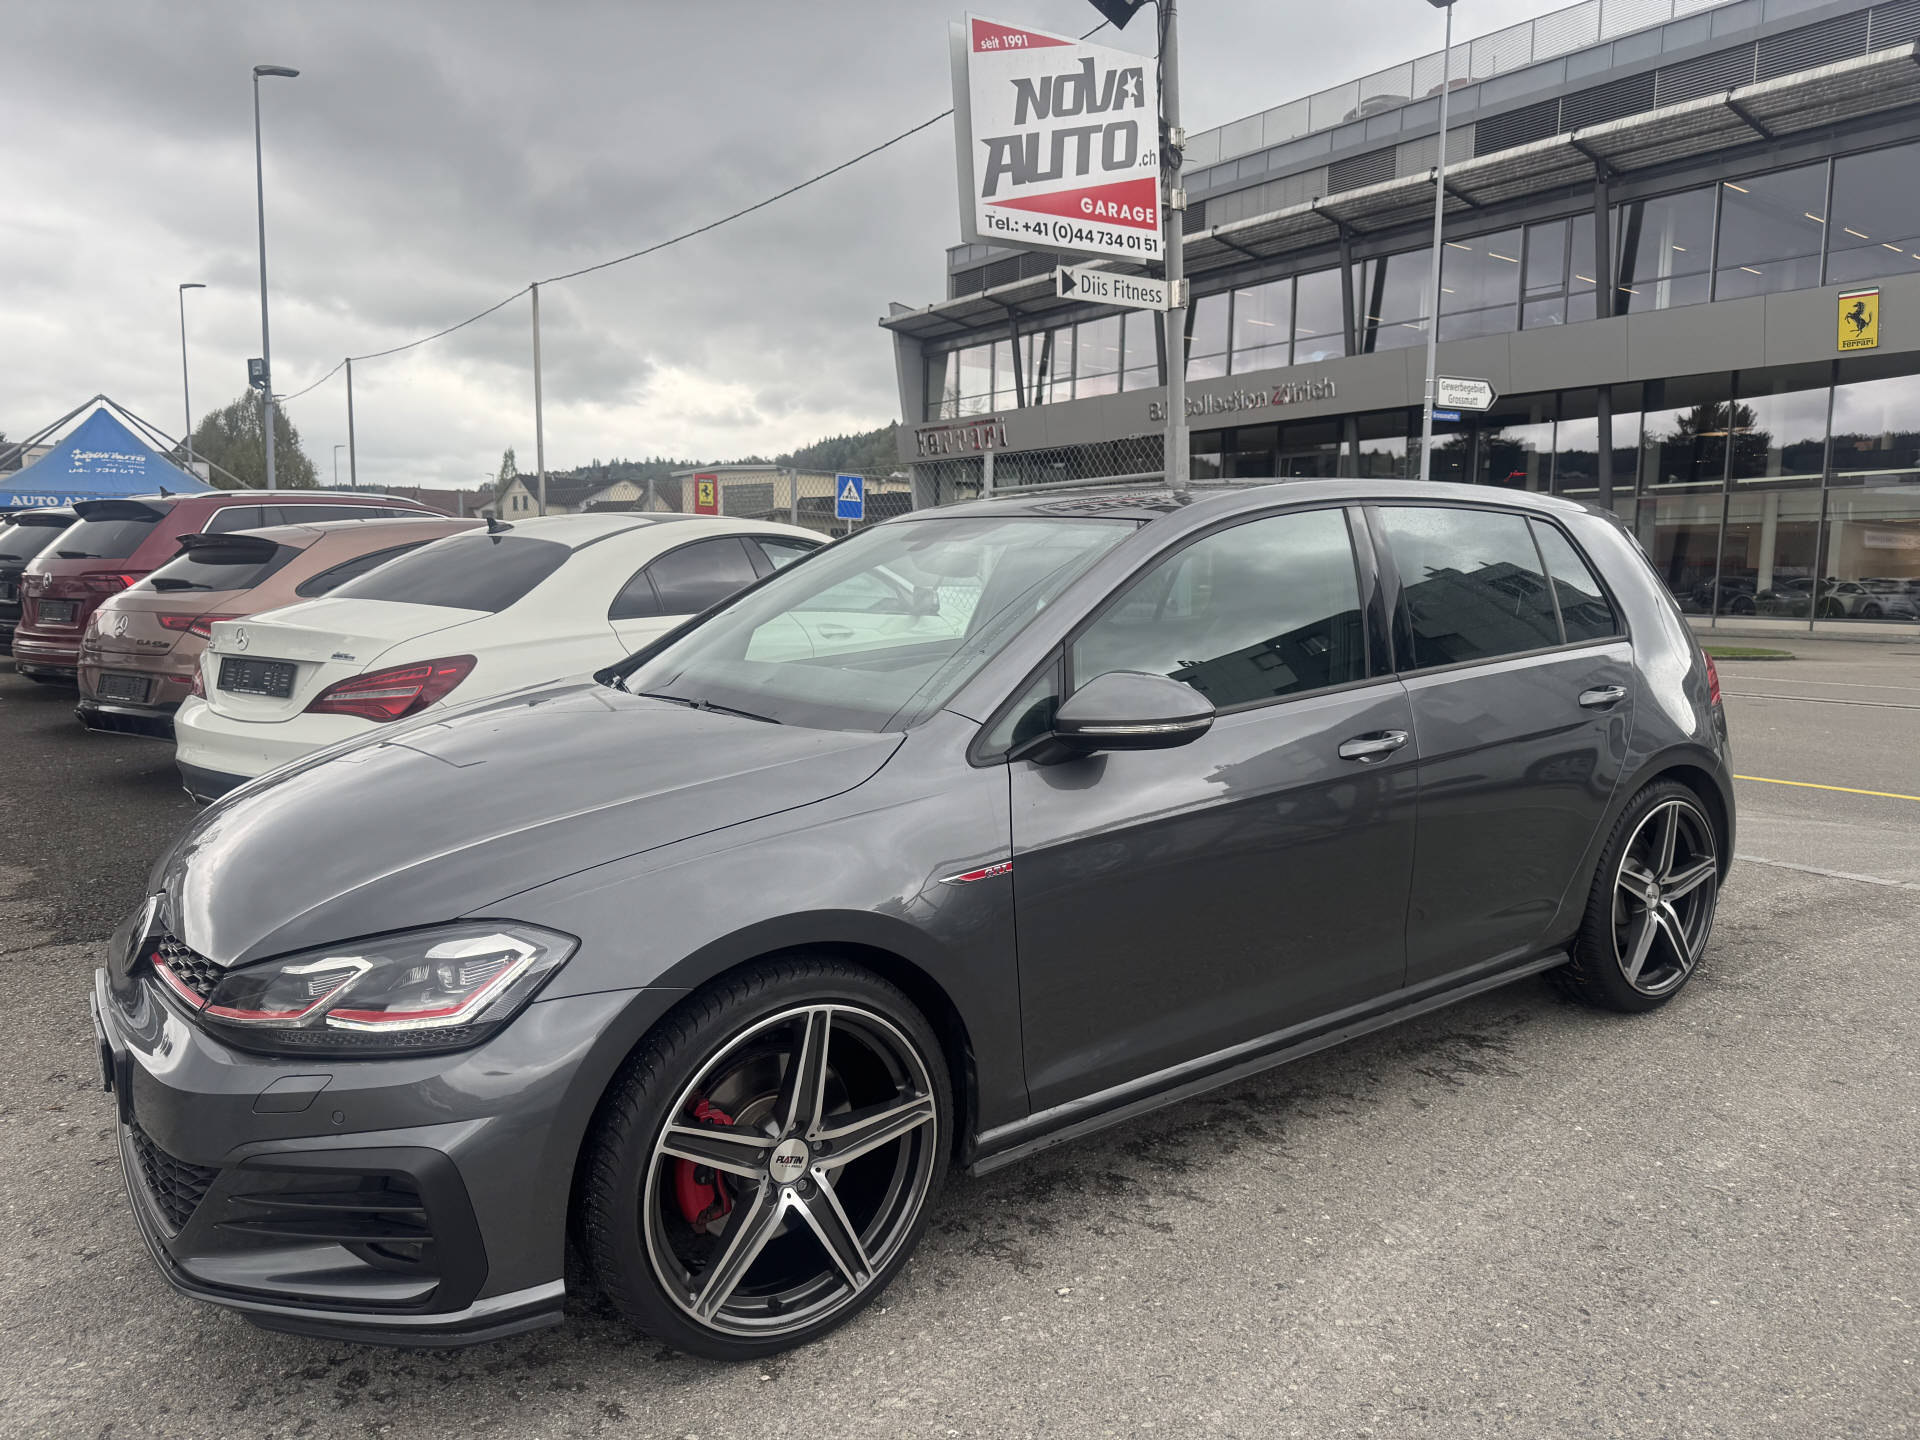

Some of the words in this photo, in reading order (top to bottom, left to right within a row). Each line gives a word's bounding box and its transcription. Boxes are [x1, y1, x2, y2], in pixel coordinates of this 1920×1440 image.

[980, 36, 1000, 49] seit
[1002, 34, 1029, 48] 1991
[1010, 56, 1145, 126] NOVA
[980, 119, 1139, 198] AUTO
[1138, 149, 1157, 168] .ch
[1080, 197, 1155, 224] GARAGE
[985, 214, 1020, 233] Tel.:
[1022, 221, 1049, 237] +41
[1097, 230, 1124, 248] 734
[1127, 235, 1142, 250] 01
[1144, 238, 1159, 253] 51
[1081, 274, 1109, 297] Diis
[1113, 279, 1163, 304] Fitness
[1842, 337, 1874, 348] Ferrari
[1271, 376, 1336, 406] Zürich
[8, 495, 59, 507] AUTO
[775, 1155, 804, 1165] PLATIN
